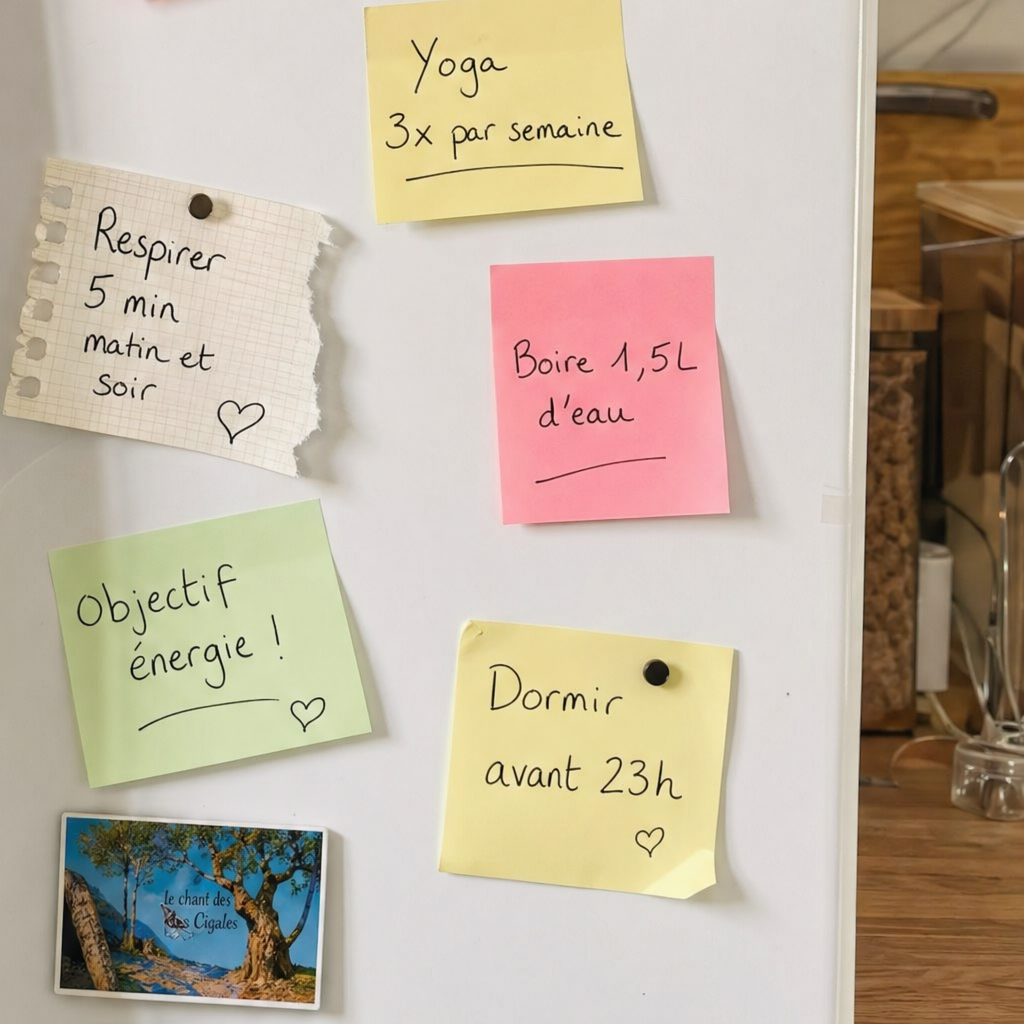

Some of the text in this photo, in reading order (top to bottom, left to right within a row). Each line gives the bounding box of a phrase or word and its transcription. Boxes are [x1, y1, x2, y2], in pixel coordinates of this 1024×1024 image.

[410, 36, 508, 99] Yoga
[385, 112, 623, 161] 3x par semaine
[93, 205, 228, 280] Respirer
[83, 273, 180, 324] 5 min
[83, 331, 215, 372] matin et
[513, 338, 698, 383] Boire 1,5L
[92, 373, 158, 401] soir
[538, 393, 635, 428] d'eau
[76, 563, 237, 639] Objectif
[129, 613, 284, 690] énergie !
[488, 663, 624, 716] Dormir
[484, 754, 683, 800] avant 23h
[178, 888, 209, 906] chant
[213, 890, 231, 907] des
[194, 911, 238, 934] Cigales
